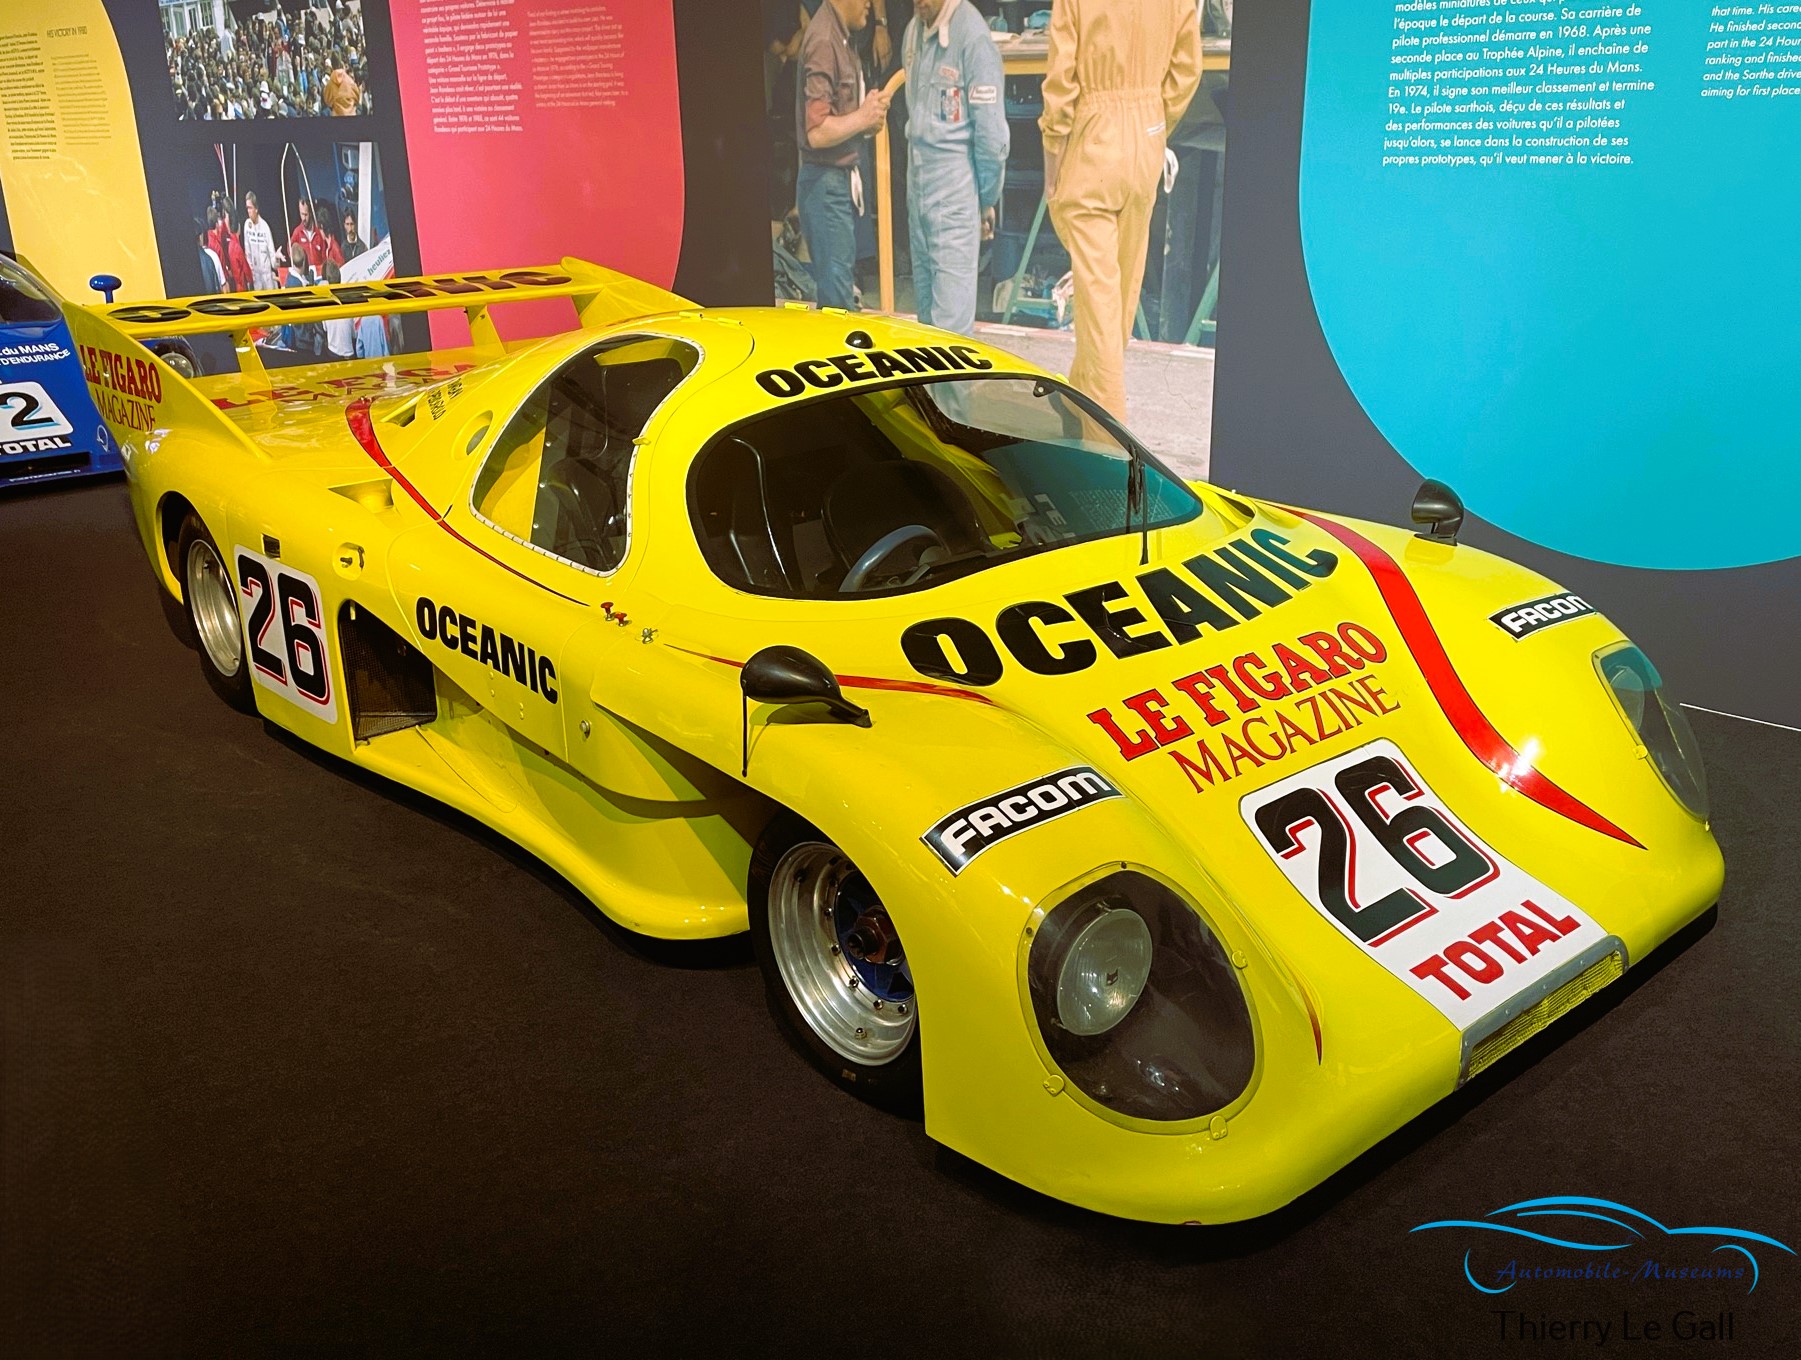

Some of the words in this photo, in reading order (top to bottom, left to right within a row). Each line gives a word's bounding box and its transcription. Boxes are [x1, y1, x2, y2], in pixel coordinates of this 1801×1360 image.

[1440, 15, 1448, 26] le
[1451, 14, 1486, 28] départ
[1488, 12, 1502, 23] de
[1505, 12, 1515, 22] la
[1518, 12, 1556, 22] course.
[1560, 9, 1575, 19] Sa
[1578, 7, 1622, 18] carrière
[1626, 6, 1641, 16] de
[1711, 5, 1730, 16] that
[1732, 6, 1754, 15] time.
[1758, 4, 1774, 13] His
[1709, 22, 1724, 32] He
[1726, 20, 1765, 31] finished
[1392, 35, 1419, 49] pilote
[1422, 31, 1489, 48] professionnel
[1491, 30, 1536, 41] démarre
[1539, 30, 1552, 39] en
[1559, 26, 1589, 37] 1968.
[1593, 25, 1626, 39] Après
[1630, 26, 1651, 34] une
[1706, 39, 1728, 50] part
[1729, 38, 1738, 47] in
[1741, 36, 1756, 47] the
[1758, 36, 1773, 46] 24
[1391, 51, 1432, 63] seconde
[1483, 48, 1524, 62] Trophée
[1526, 46, 1564, 60] Alpine,
[1568, 45, 1574, 55] il
[1577, 44, 1630, 55] enchaîne
[1633, 43, 1648, 53] de
[1705, 53, 1742, 66] ranking
[1744, 52, 1765, 63] and
[1766, 51, 1801, 62] finishe
[1389, 68, 1431, 82] multiples
[1434, 67, 1503, 82] participations
[1506, 68, 1525, 76] aux
[1529, 64, 1543, 75] 24
[1547, 64, 1585, 74] Heures
[1588, 63, 1603, 73] du
[1606, 62, 1642, 72] Mans.
[1703, 70, 1723, 80] and
[1724, 69, 1739, 80] the
[1742, 68, 1774, 79] Sarthe
[1388, 86, 1400, 97] En
[1405, 85, 1429, 97] 1974,
[1433, 85, 1439, 95] il
[1441, 85, 1468, 98] signe
[1491, 83, 1533, 94] meilleur
[1535, 81, 1596, 92] classement
[1598, 81, 1609, 91] et
[1612, 80, 1654, 90] termine
[1701, 87, 1734, 98] aiming
[1736, 84, 1750, 95] for
[1752, 84, 1770, 95] first
[1389, 103, 1407, 113] 19e.
[1411, 102, 1421, 113] Le
[1424, 102, 1451, 116] pilote
[1454, 101, 1495, 113] sarthois,
[1499, 101, 1525, 113] déçu
[1528, 100, 1542, 110] de
[1566, 99, 1610, 110] résultats
[1613, 99, 1624, 109] et
[1385, 119, 1402, 130] des
[1404, 119, 1472, 133] performances
[1475, 118, 1493, 129] des
[1496, 118, 1536, 129] voitures
[1576, 117, 1619, 131] pilotées
[1453, 136, 1481, 146] lance
[1484, 136, 1509, 146] dans
[1512, 135, 1522, 146] la
[1525, 135, 1589, 146] construction
[1593, 135, 1607, 145] de
[1382, 156, 1419, 166] propres
[1421, 154, 1476, 166] prototypes,
[1505, 154, 1527, 163] veut
[1566, 153, 1573, 163] à
[1576, 153, 1587, 163] la
[1590, 153, 1632, 163] victoire.
[106, 271, 572, 323] OCEANIC
[18, 342, 59, 354] MANS
[100, 349, 162, 404] FIGARO
[755, 346, 993, 398] OCEANIC
[0, 438, 72, 455] OTAL
[900, 528, 1338, 686] OCEANIC
[238, 554, 330, 706] 26
[416, 596, 558, 704] OCEANIC
[1086, 686, 1196, 762] LE
[1172, 622, 1388, 728] FIGARO
[1168, 675, 1401, 794] MAGAZINE
[940, 772, 1112, 857] FACOM
[1254, 755, 1500, 948] 26
[1409, 899, 1581, 1001] TOTAL
